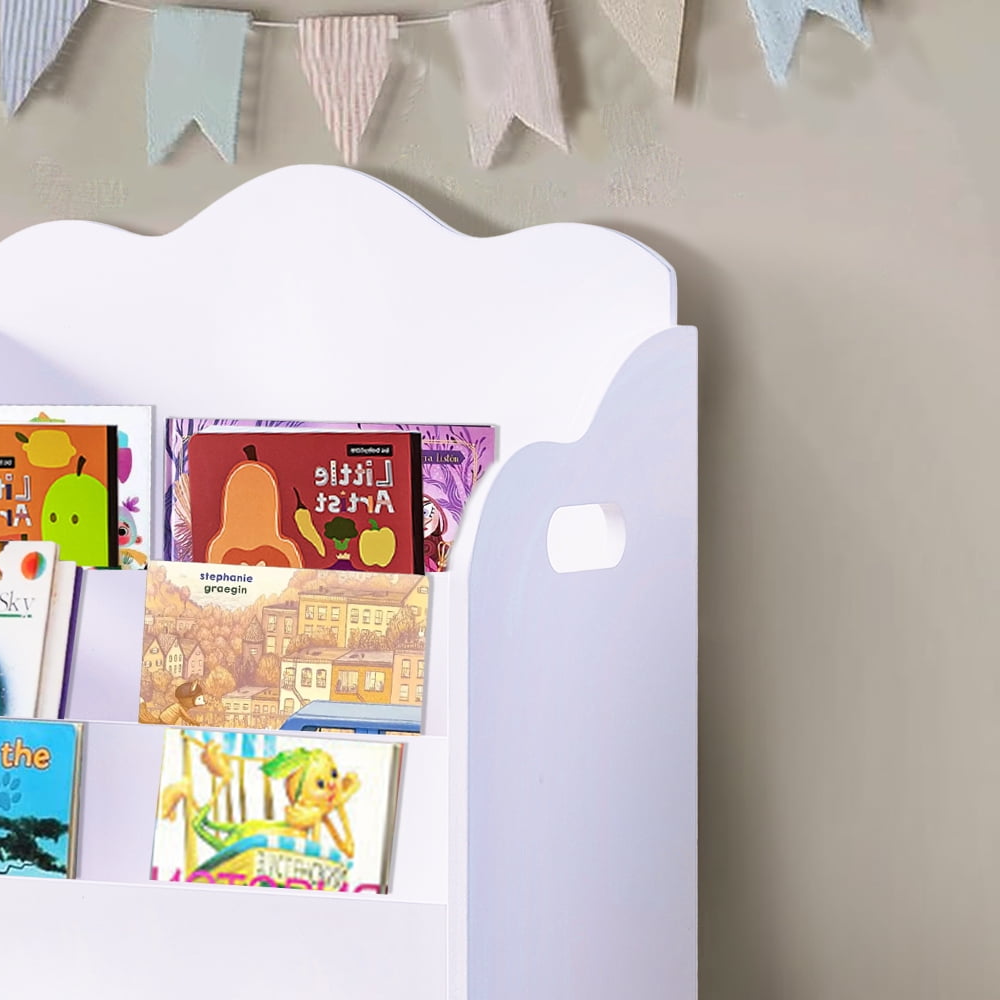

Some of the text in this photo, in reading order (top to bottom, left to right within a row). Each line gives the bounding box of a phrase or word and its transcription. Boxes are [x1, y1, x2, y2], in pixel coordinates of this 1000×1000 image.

[200, 572, 253, 583] stephanie
[204, 585, 247, 595] graegin
[0, 737, 51, 770] the
